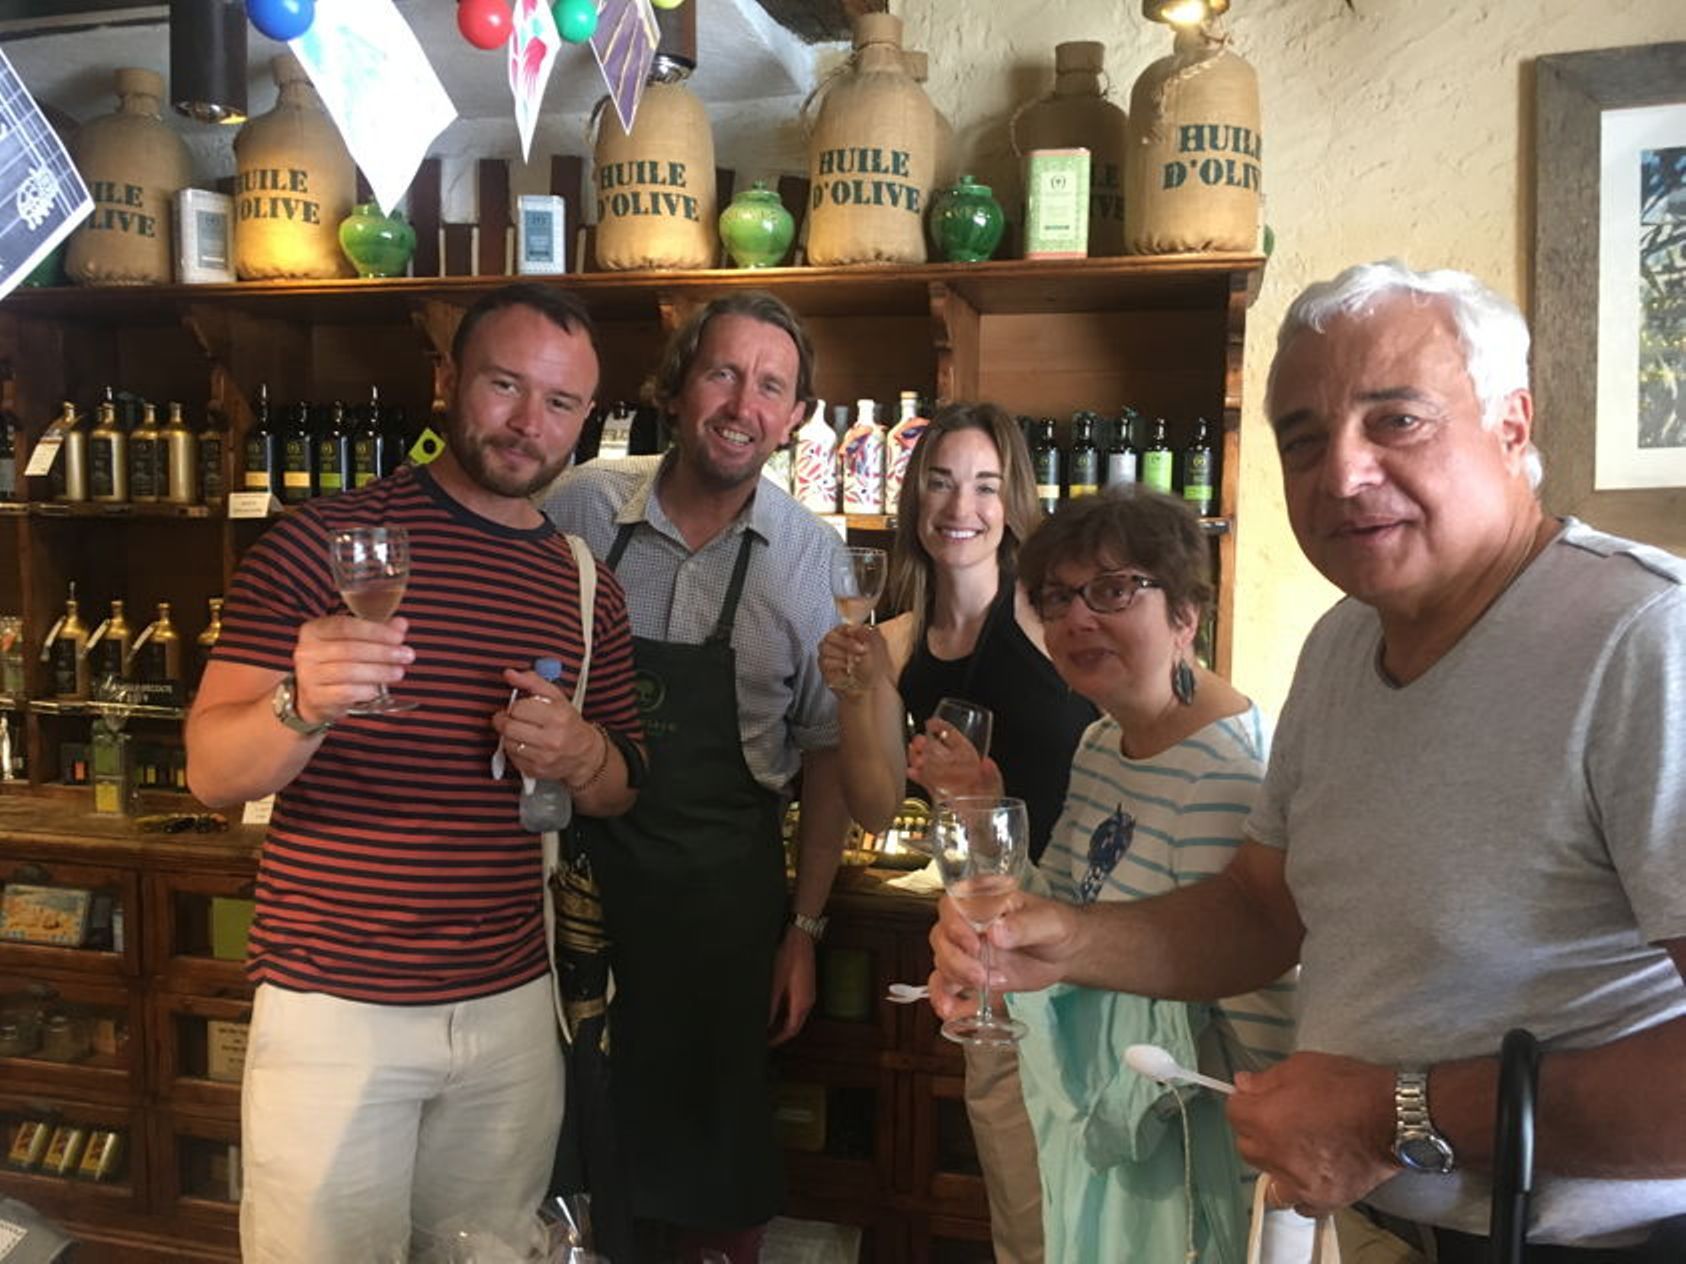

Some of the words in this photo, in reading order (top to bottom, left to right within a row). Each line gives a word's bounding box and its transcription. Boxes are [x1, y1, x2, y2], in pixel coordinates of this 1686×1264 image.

[600, 159, 687, 190] HUILE
[819, 147, 910, 178] HUILE
[1162, 157, 1262, 191] D'OLIV
[89, 181, 144, 209] ILE
[240, 168, 308, 194] UILE
[239, 196, 321, 225] OLIVE
[812, 180, 921, 214] D'OLIVE
